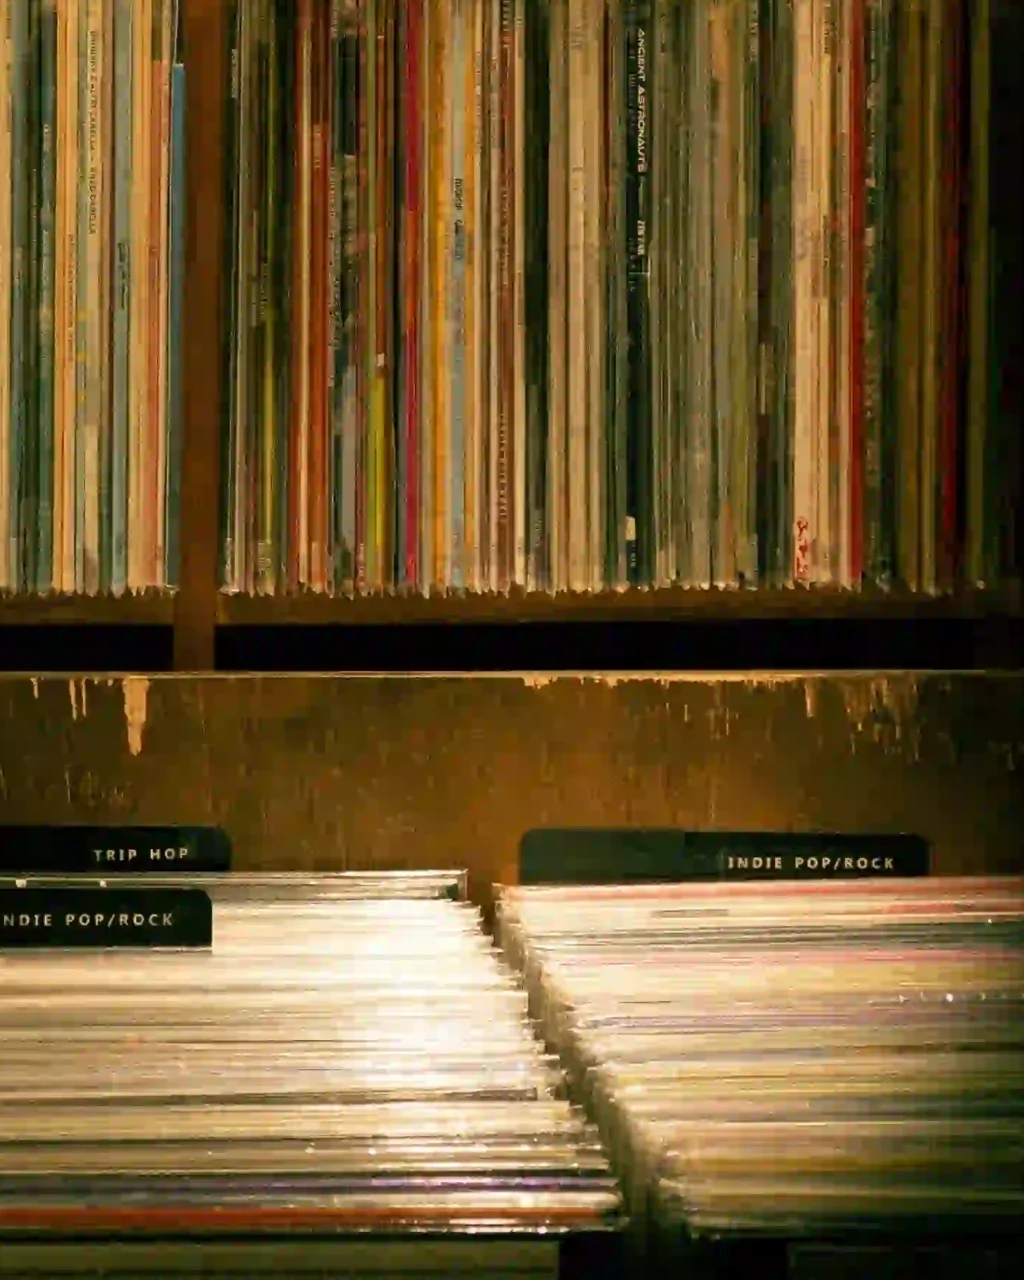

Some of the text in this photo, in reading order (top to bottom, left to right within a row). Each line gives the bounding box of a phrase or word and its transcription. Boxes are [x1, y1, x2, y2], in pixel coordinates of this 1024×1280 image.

[636, 27, 647, 173] ANCIENT ASTRONAUTS
[93, 847, 189, 862] TRIP HOP
[727, 856, 895, 870] INDIE POP/ROCK
[65, 912, 174, 928] POP/ROCK
